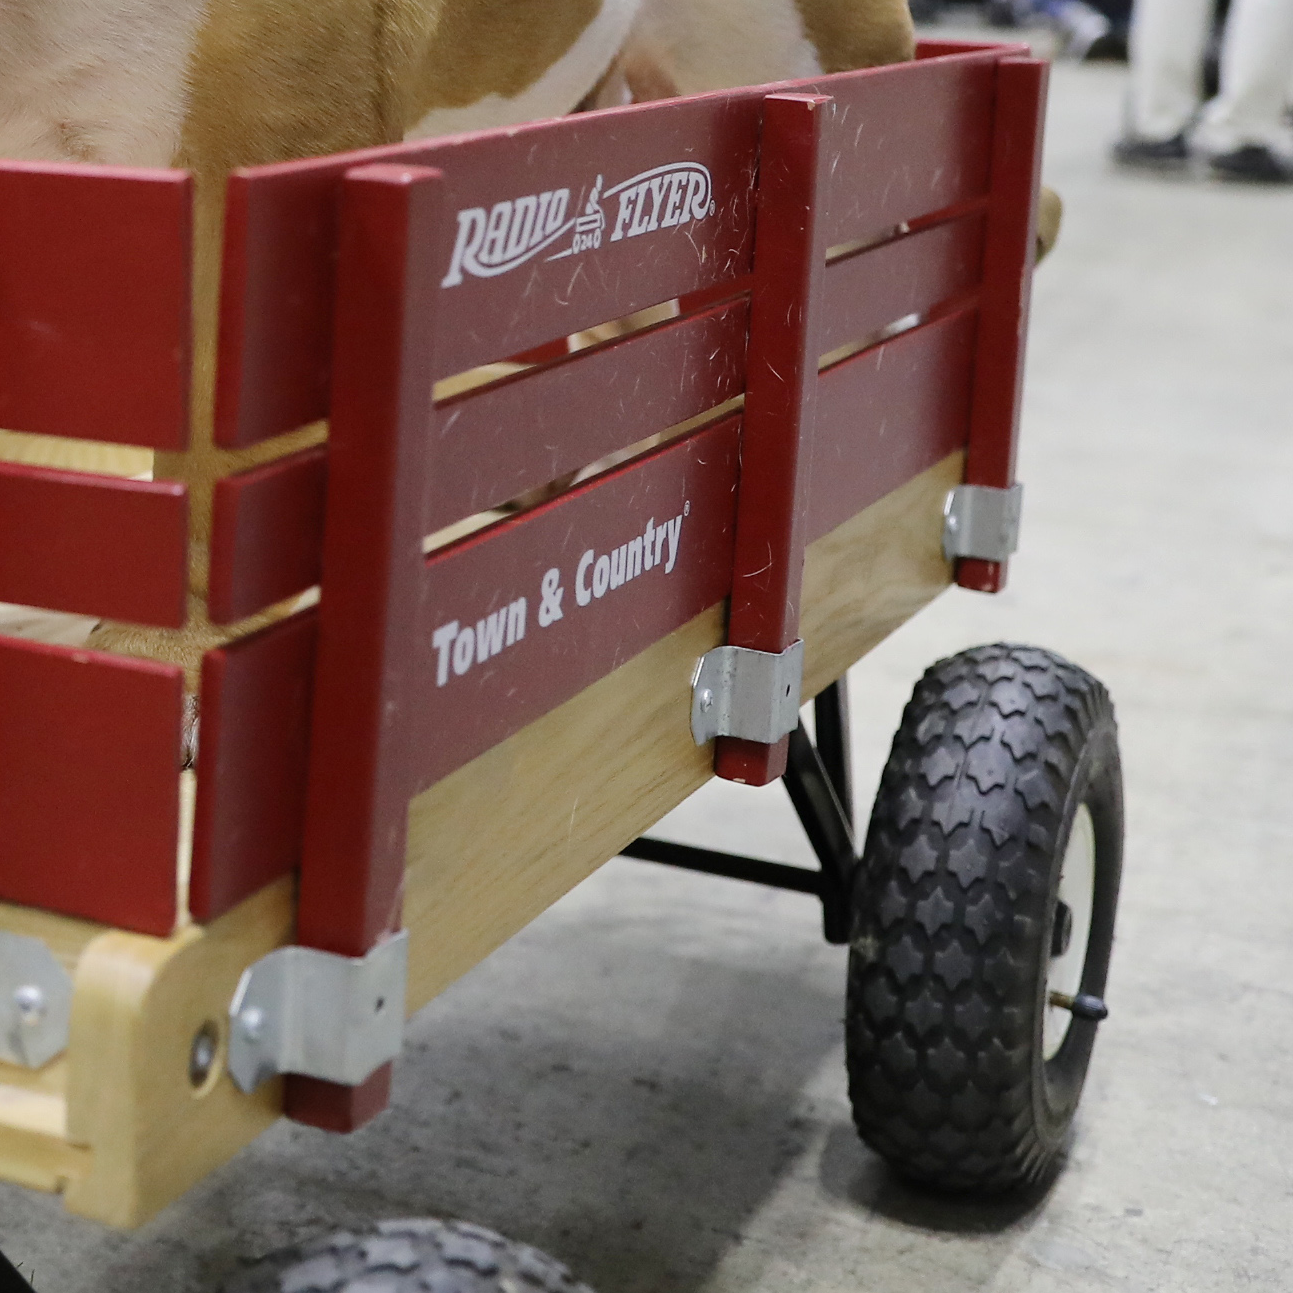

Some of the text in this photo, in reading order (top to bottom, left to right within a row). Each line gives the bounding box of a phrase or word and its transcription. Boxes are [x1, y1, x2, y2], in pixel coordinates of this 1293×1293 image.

[441, 171, 708, 289] RADIO FLYER
[432, 514, 683, 688] Town & Country
